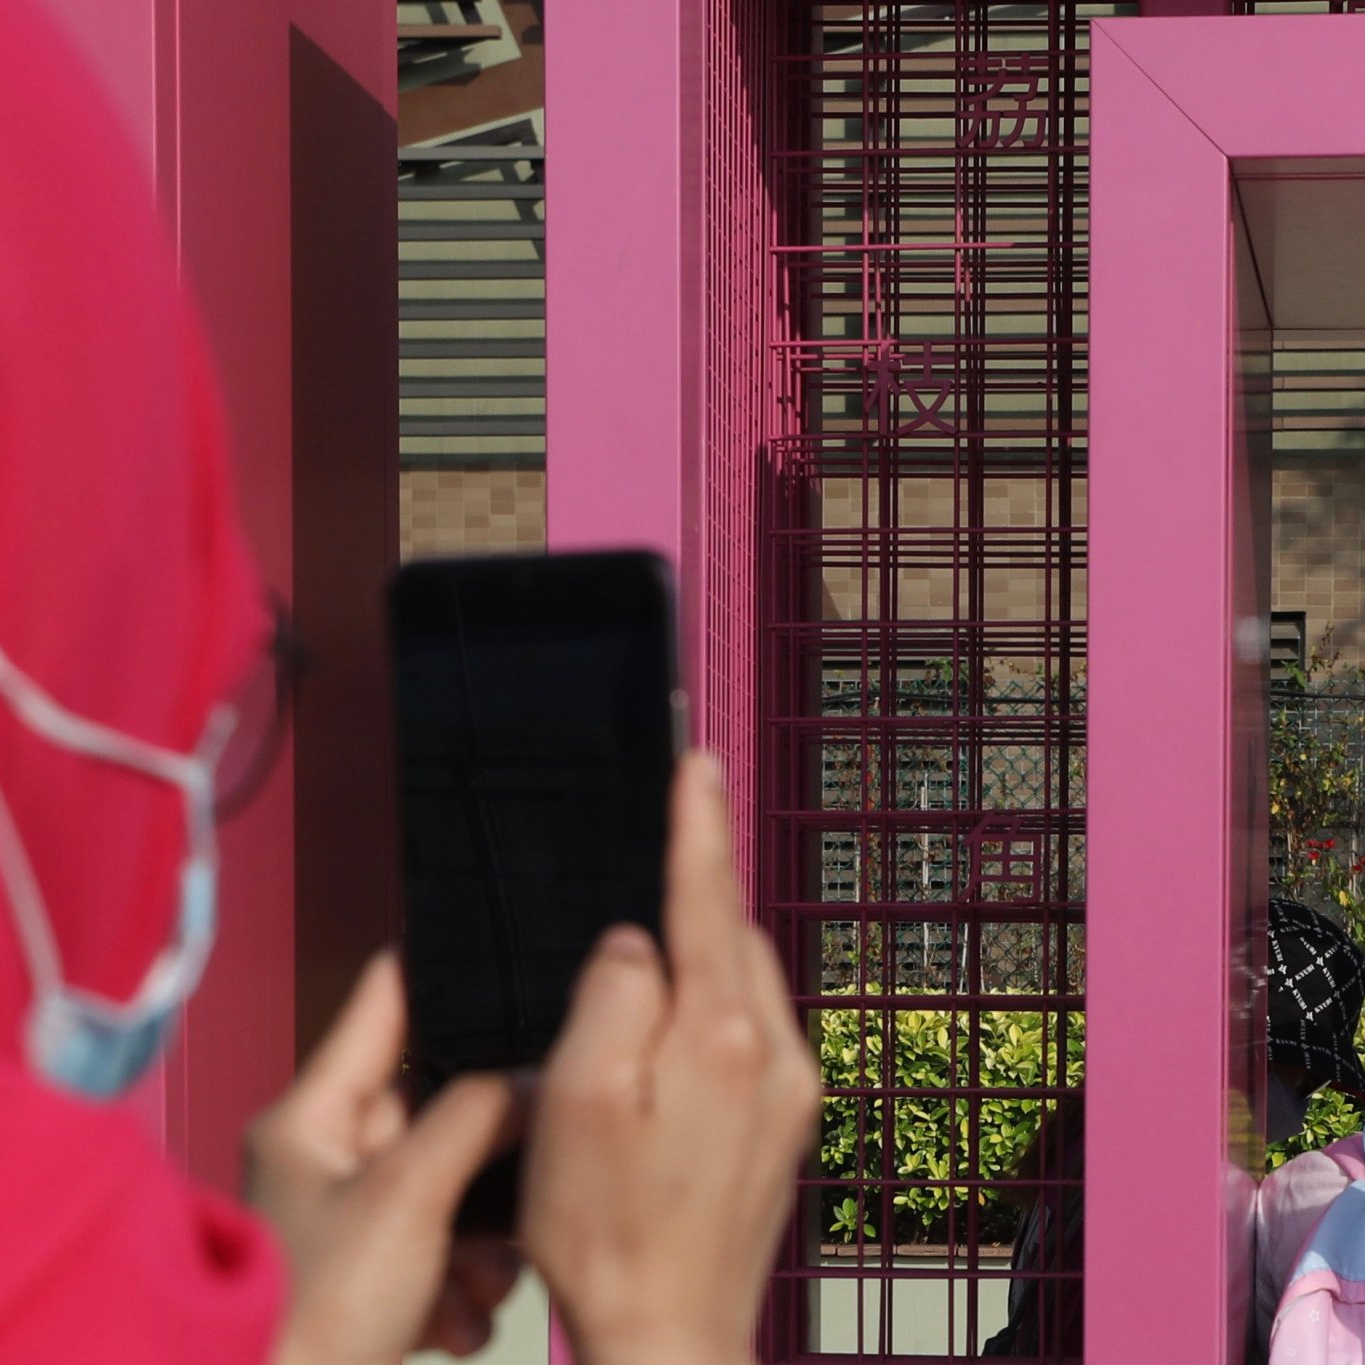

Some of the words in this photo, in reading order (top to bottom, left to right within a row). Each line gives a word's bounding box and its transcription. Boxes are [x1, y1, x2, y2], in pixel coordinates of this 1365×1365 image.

[958, 54, 1048, 149] 荔
[863, 341, 959, 436] 枝
[960, 812, 1042, 904] 角
